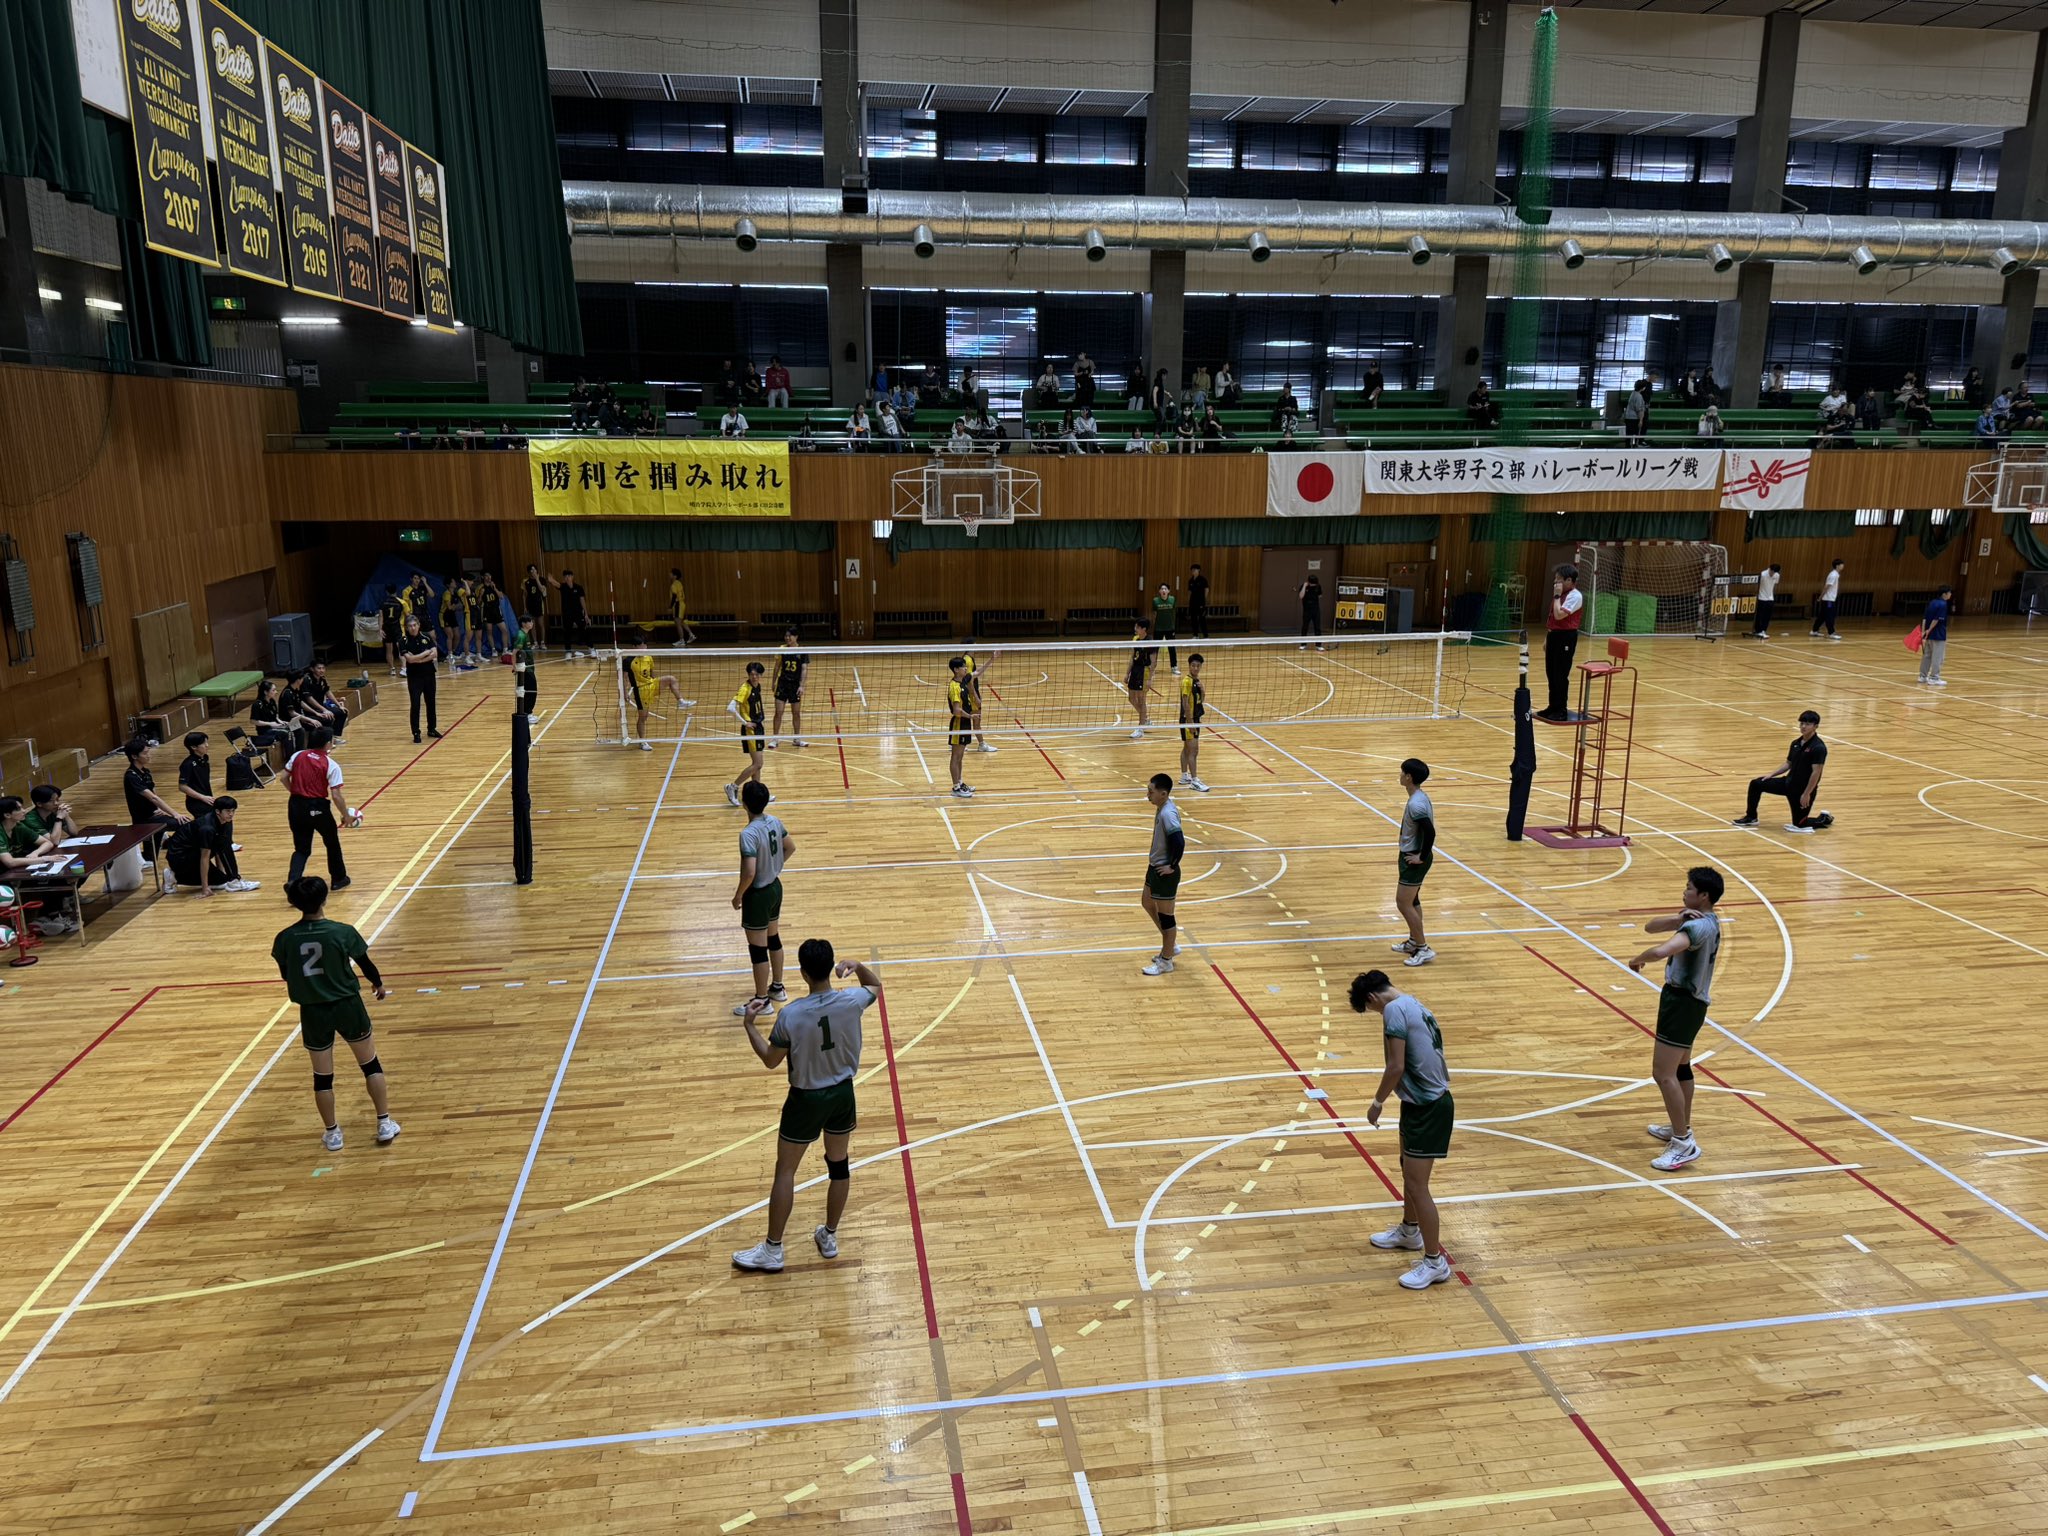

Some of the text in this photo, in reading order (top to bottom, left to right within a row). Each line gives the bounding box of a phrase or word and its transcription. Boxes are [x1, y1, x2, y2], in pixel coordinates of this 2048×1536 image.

[211, 27, 254, 84] Daito
[144, 57, 158, 82] ALL
[159, 65, 181, 94] KANTO
[277, 73, 312, 122] Daito
[227, 108, 238, 135] ALL
[331, 109, 360, 152] Daito
[376, 141, 400, 177] Daito
[164, 187, 200, 236] 2007
[242, 220, 270, 259] 2017
[302, 242, 327, 278] 2019
[349, 260, 371, 291] 2021
[388, 276, 408, 304] 2022
[541, 460, 784, 492] 勝利を掴み取れ
[1982, 542, 1989, 553] B
[848, 562, 858, 575] A
[389, 607, 394, 618] 1
[486, 594, 495, 602] 10
[1340, 608, 1383, 619] 00 1 00
[785, 661, 797, 672] 23
[768, 830, 778, 857] 6
[300, 942, 324, 977] 2
[817, 1016, 835, 1051] 1
